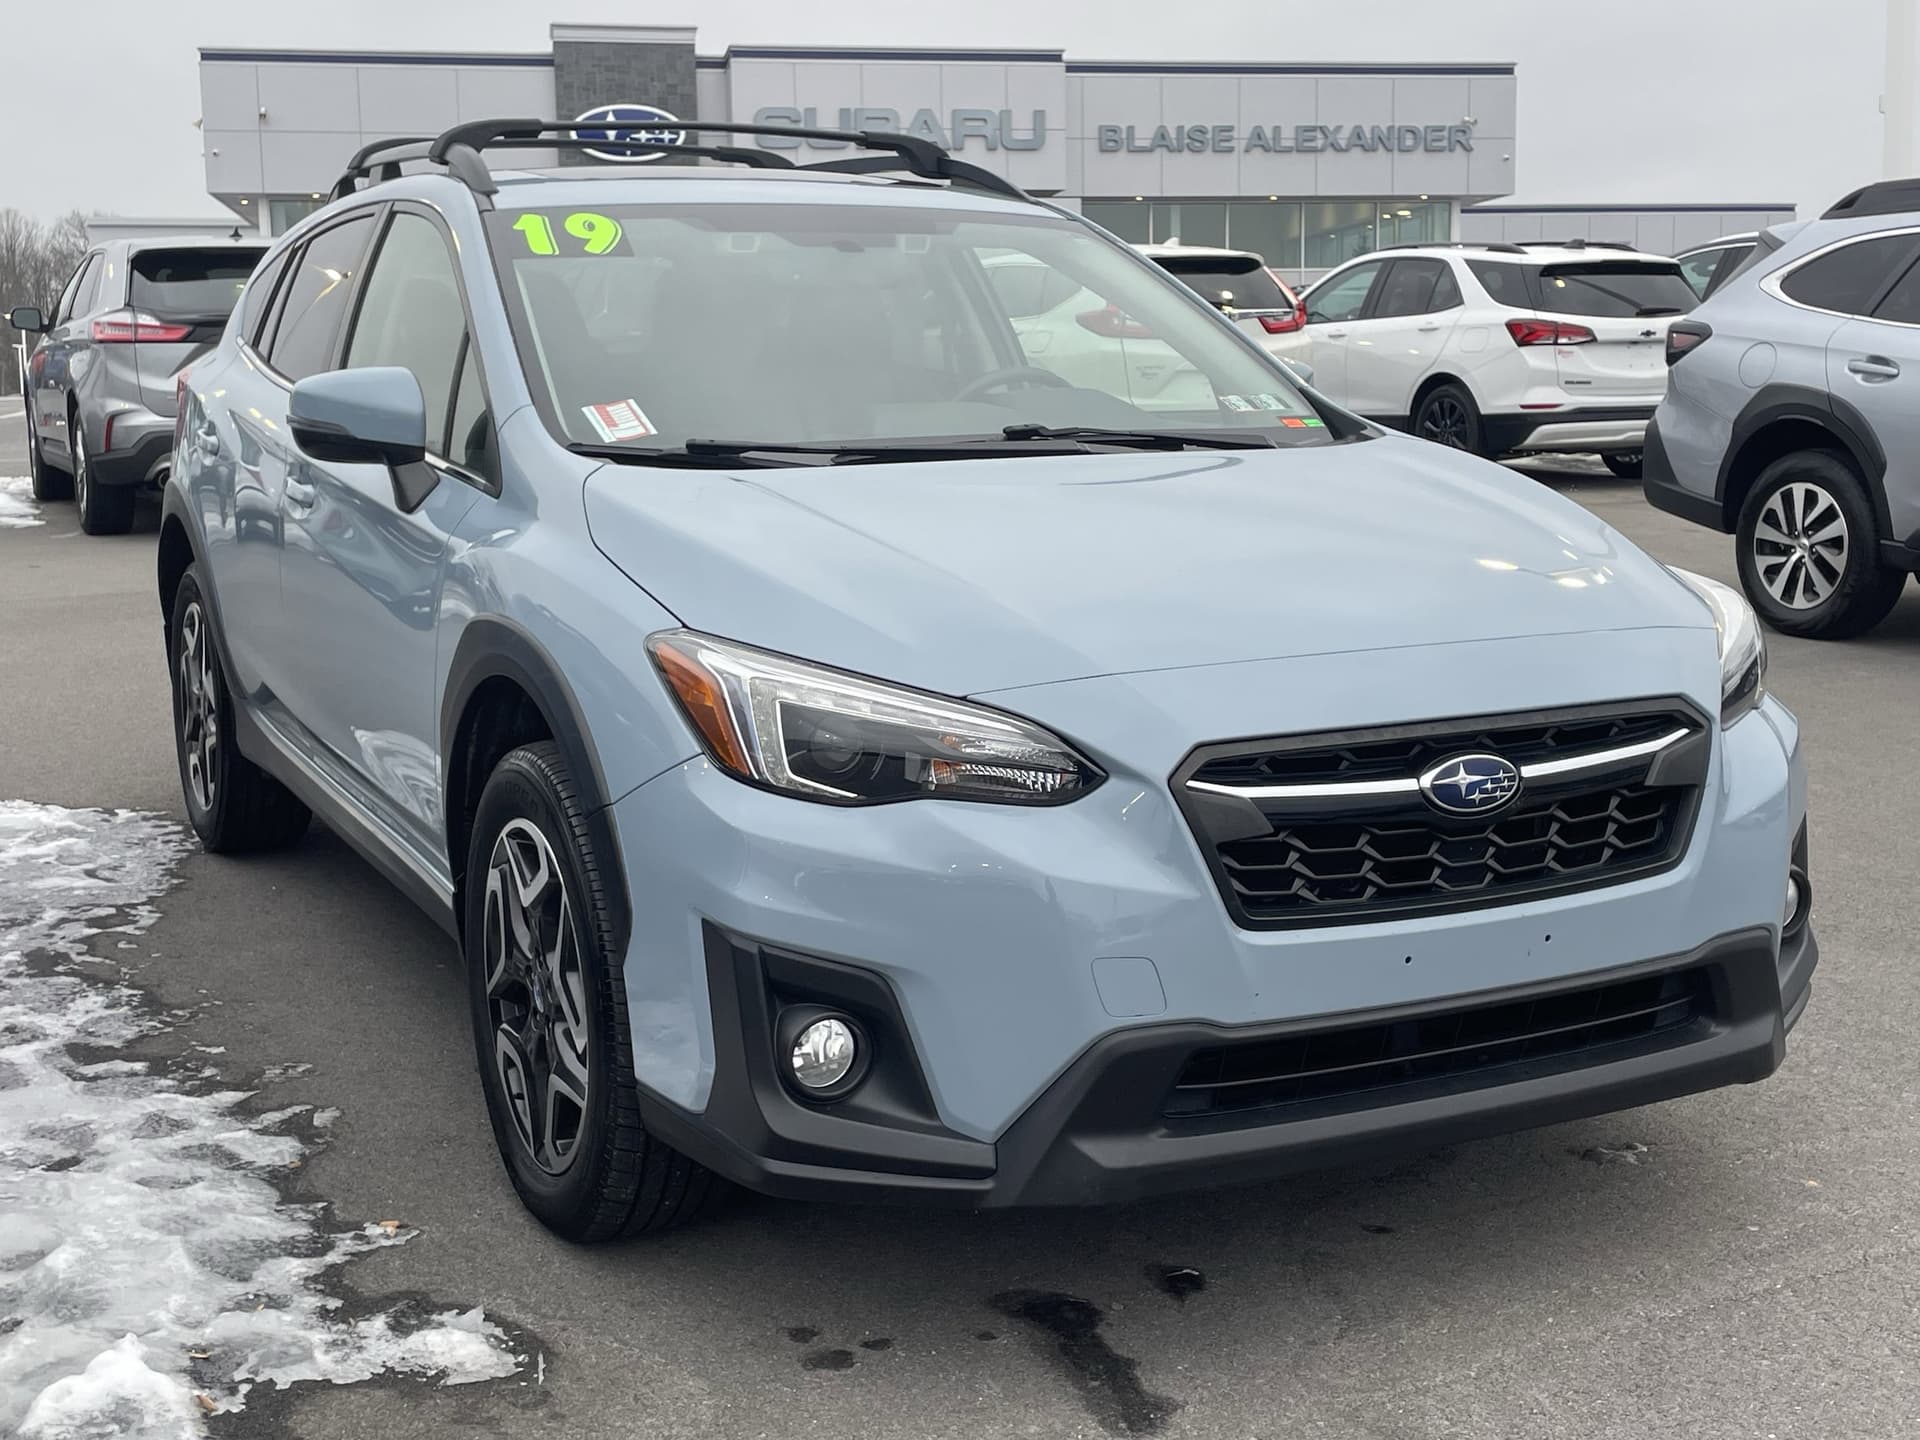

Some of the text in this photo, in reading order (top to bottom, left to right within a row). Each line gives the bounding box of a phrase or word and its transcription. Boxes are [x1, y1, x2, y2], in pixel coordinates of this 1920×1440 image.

[753, 107, 1046, 151] SUBARU
[1098, 125, 1474, 153] BLAISE ALEXANDER
[512, 212, 623, 256] 19
